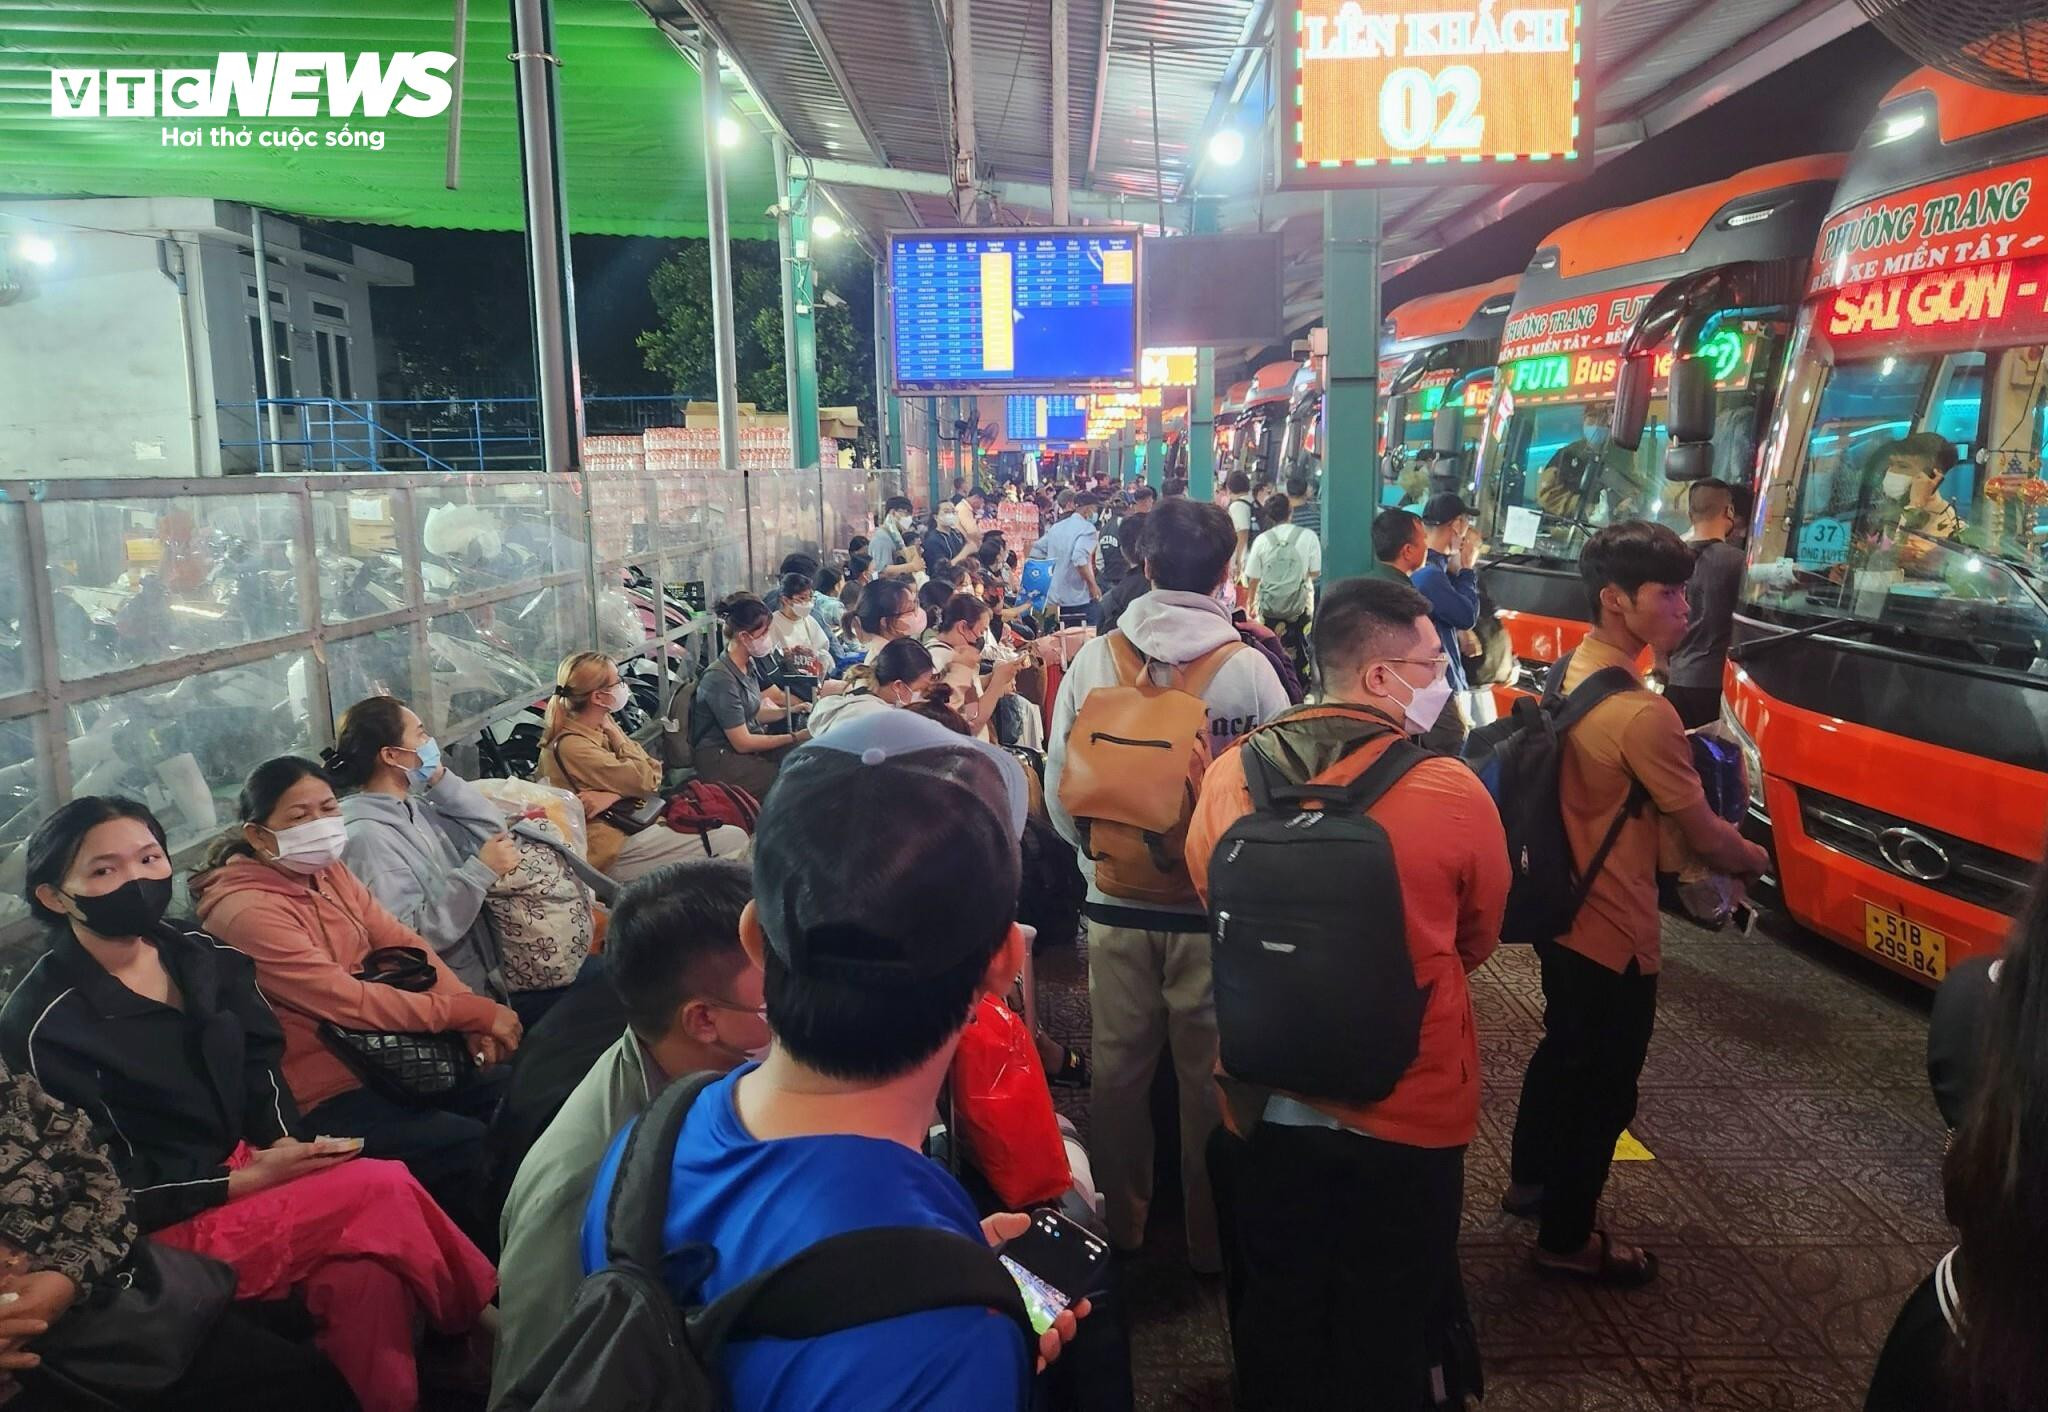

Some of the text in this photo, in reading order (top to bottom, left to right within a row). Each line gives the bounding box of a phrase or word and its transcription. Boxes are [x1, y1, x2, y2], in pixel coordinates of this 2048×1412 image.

[1304, 0, 1569, 59] LÊN KHÁCH
[1379, 65, 1485, 152] 02
[1820, 178, 2032, 263] PHƯƠNG TRANG
[1847, 259, 1878, 283] XE
[1955, 235, 2018, 261] TÂY
[1548, 303, 1598, 334] TRANG
[1514, 345, 1530, 359] XE
[1562, 334, 1590, 351] TÂY
[1513, 359, 1568, 391] FUTA
[1574, 355, 1617, 385] Bus
[1814, 524, 1838, 542] 37
[1886, 914, 1922, 947] 51B
